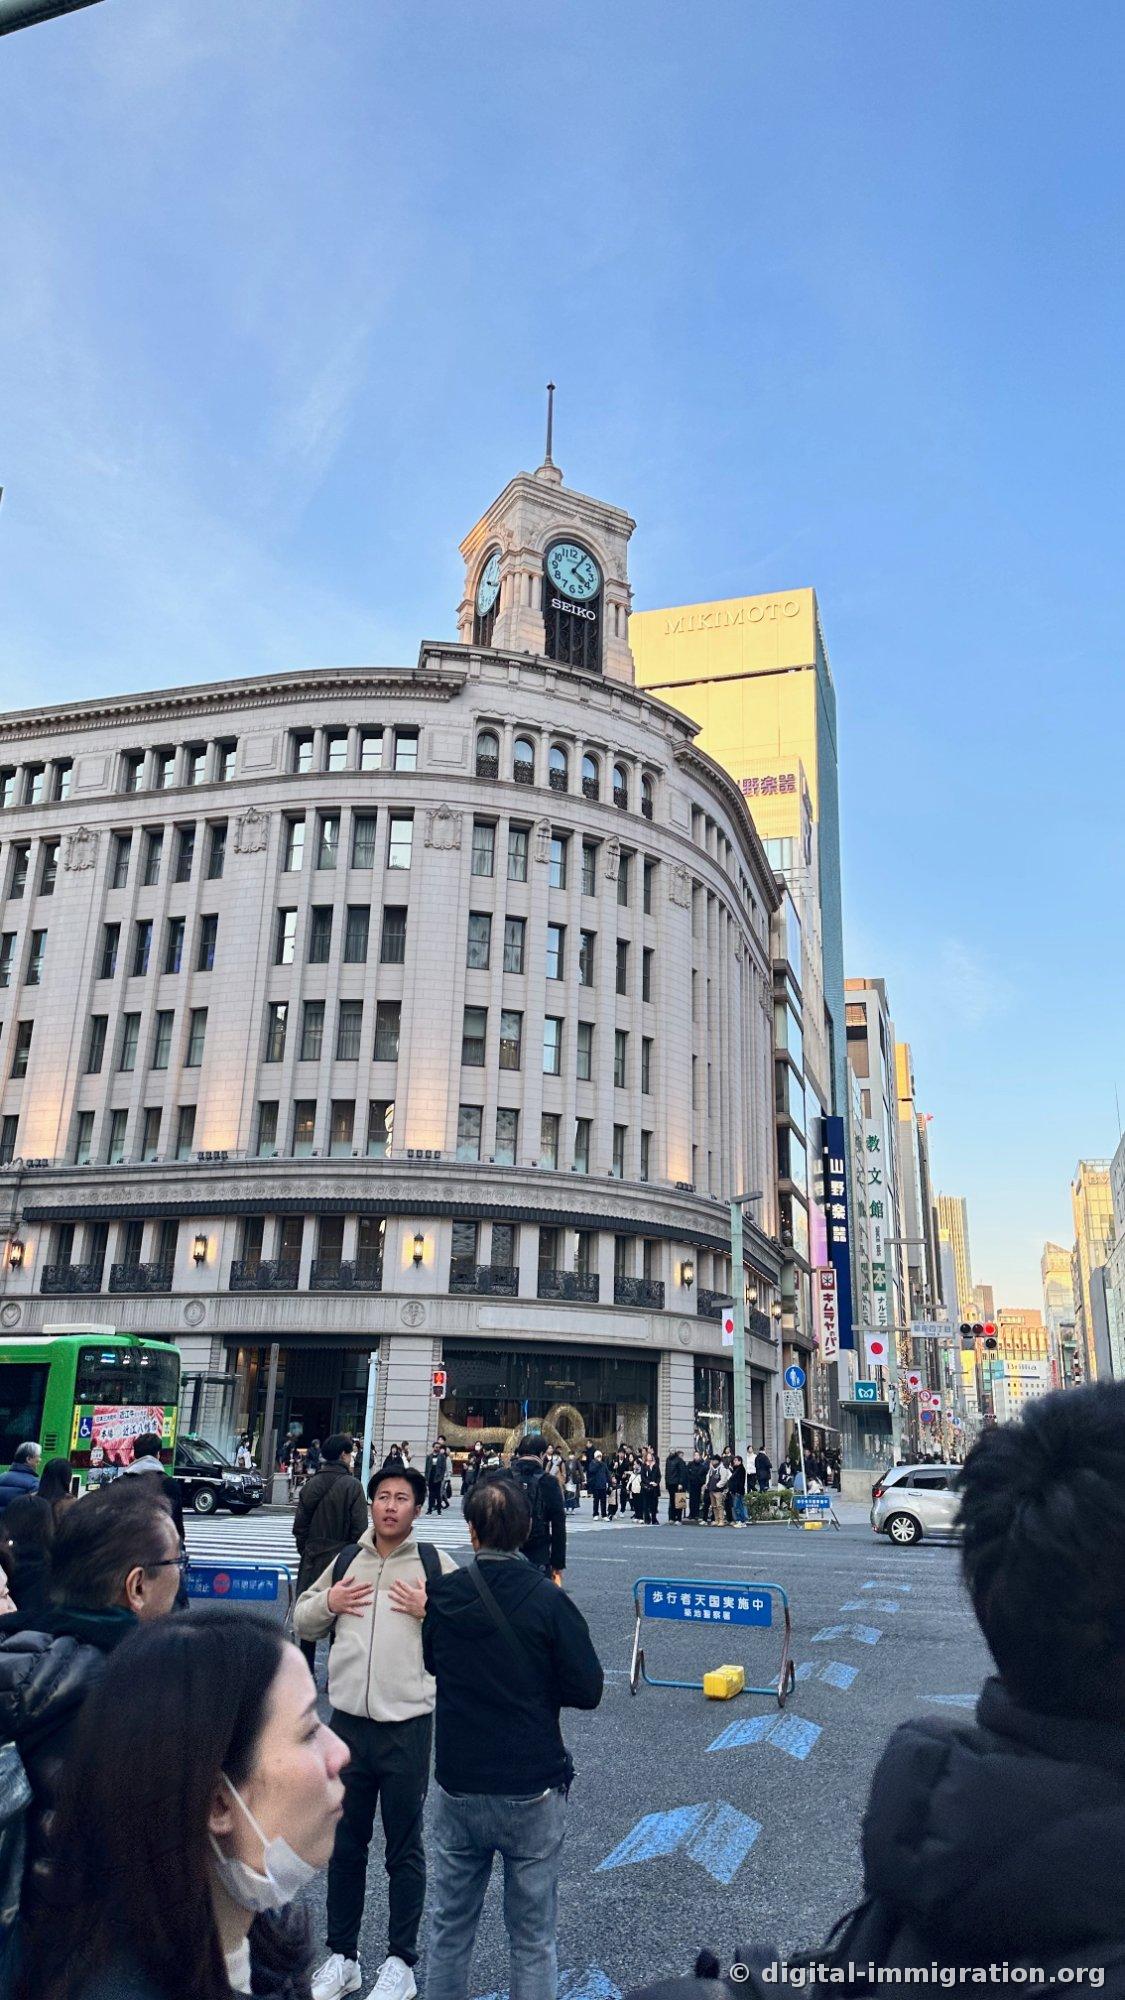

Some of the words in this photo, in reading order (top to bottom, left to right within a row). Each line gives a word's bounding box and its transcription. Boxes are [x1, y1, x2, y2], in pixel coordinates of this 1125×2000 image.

[554, 552, 562, 562] 10
[570, 549, 578, 559] 12
[552, 560, 559, 569] 9
[585, 563, 592, 572] 2
[554, 570, 561, 580] 8
[588, 573, 594, 582] 3
[562, 579, 568, 588] 7
[584, 581, 591, 590] 4
[569, 584, 576, 594] 6
[577, 585, 584, 594] 5
[552, 598, 596, 620] SEIKO
[664, 600, 800, 635] MIKIMOTO
[866, 1134, 884, 1219] 教文館
[823, 1292, 838, 1356] キムラヤのパン
[652, 1590, 764, 1611] 歩行者天国実施中
